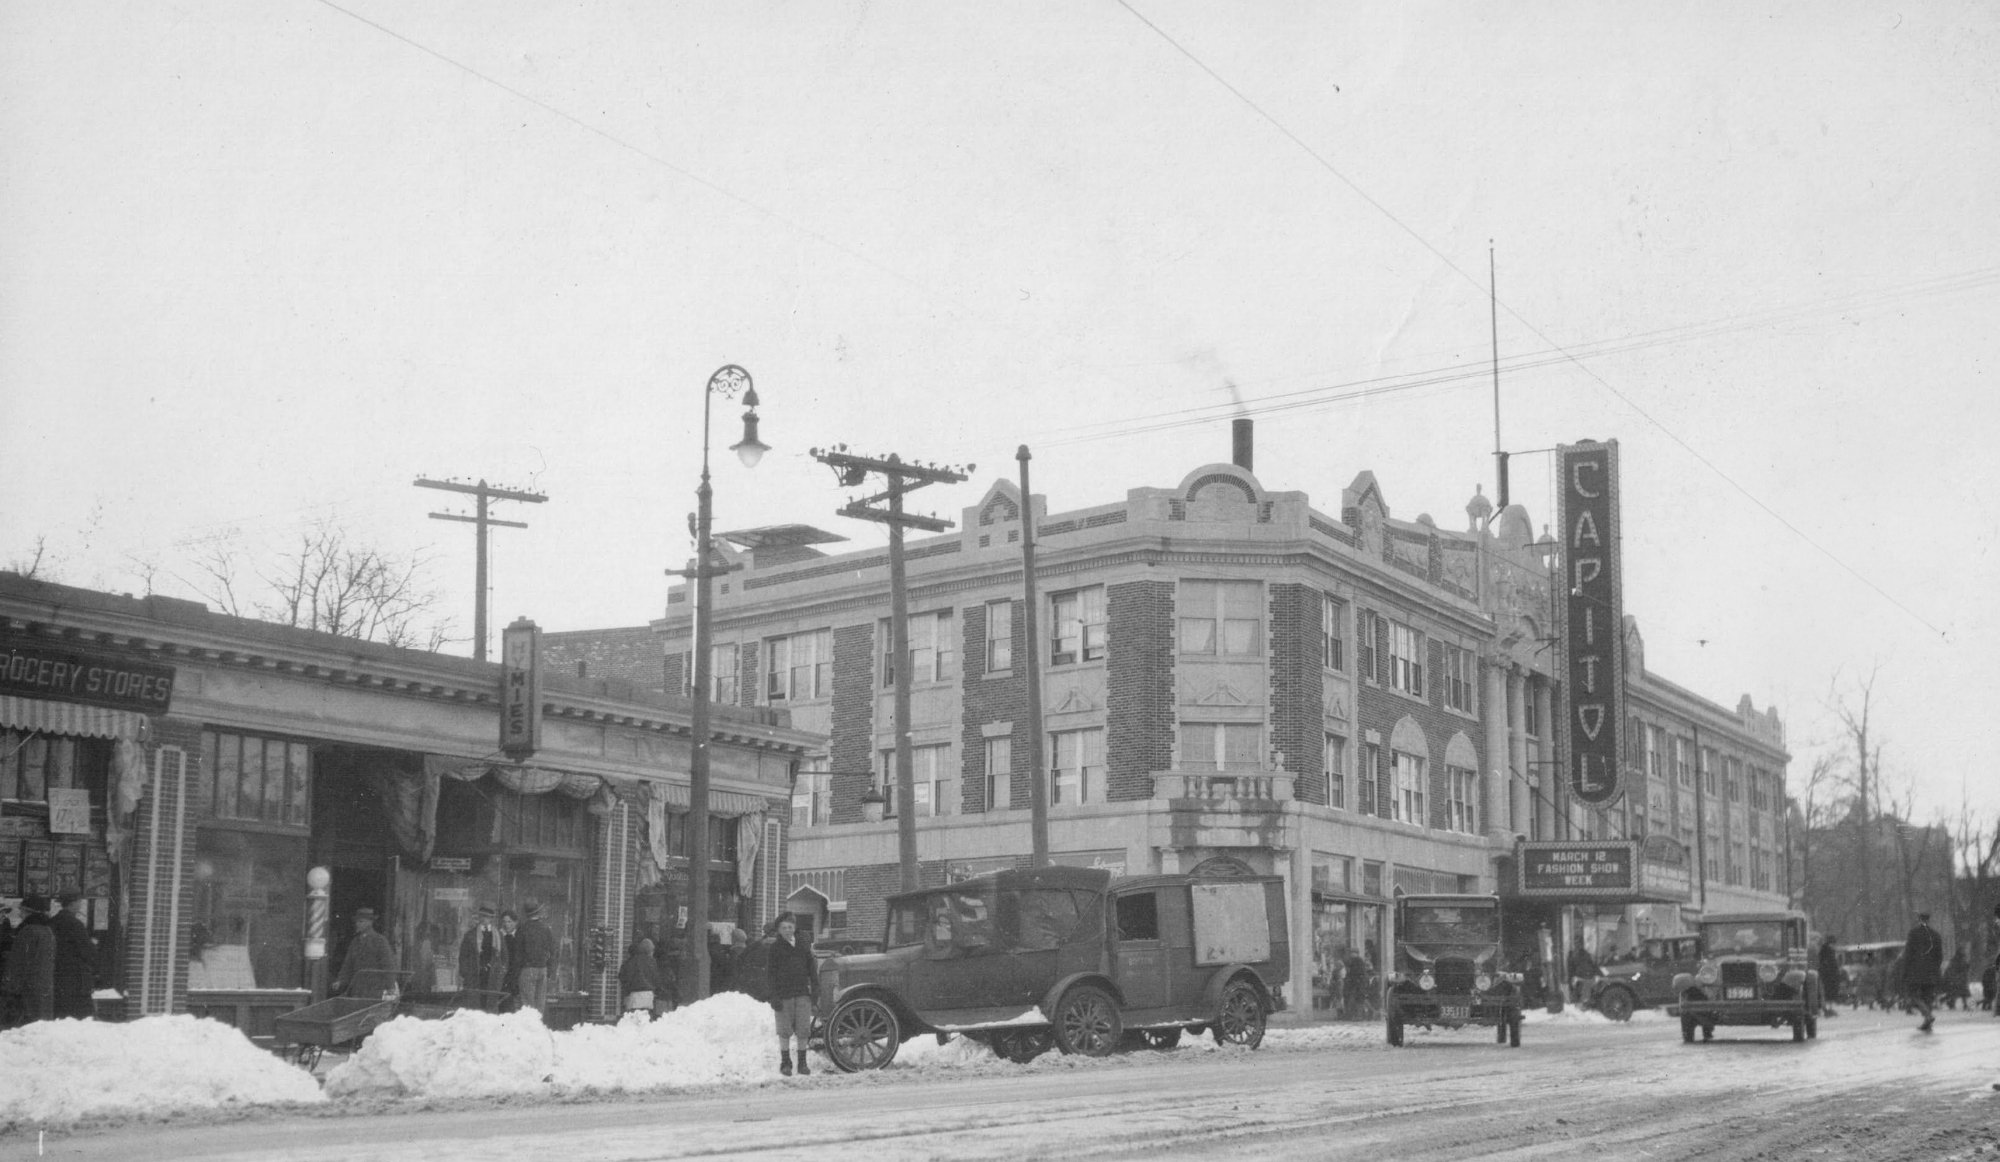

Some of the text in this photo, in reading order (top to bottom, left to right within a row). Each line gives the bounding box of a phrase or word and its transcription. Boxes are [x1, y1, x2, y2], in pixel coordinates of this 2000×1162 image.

[1573, 461, 1605, 793] CAPITOL
[86, 667, 170, 701] STORES
[511, 641, 526, 735] HYMIES
[1552, 851, 1607, 862] MARCH 12
[1538, 863, 1619, 874] FASHION SHOW
[1564, 875, 1593, 886] WEEK
